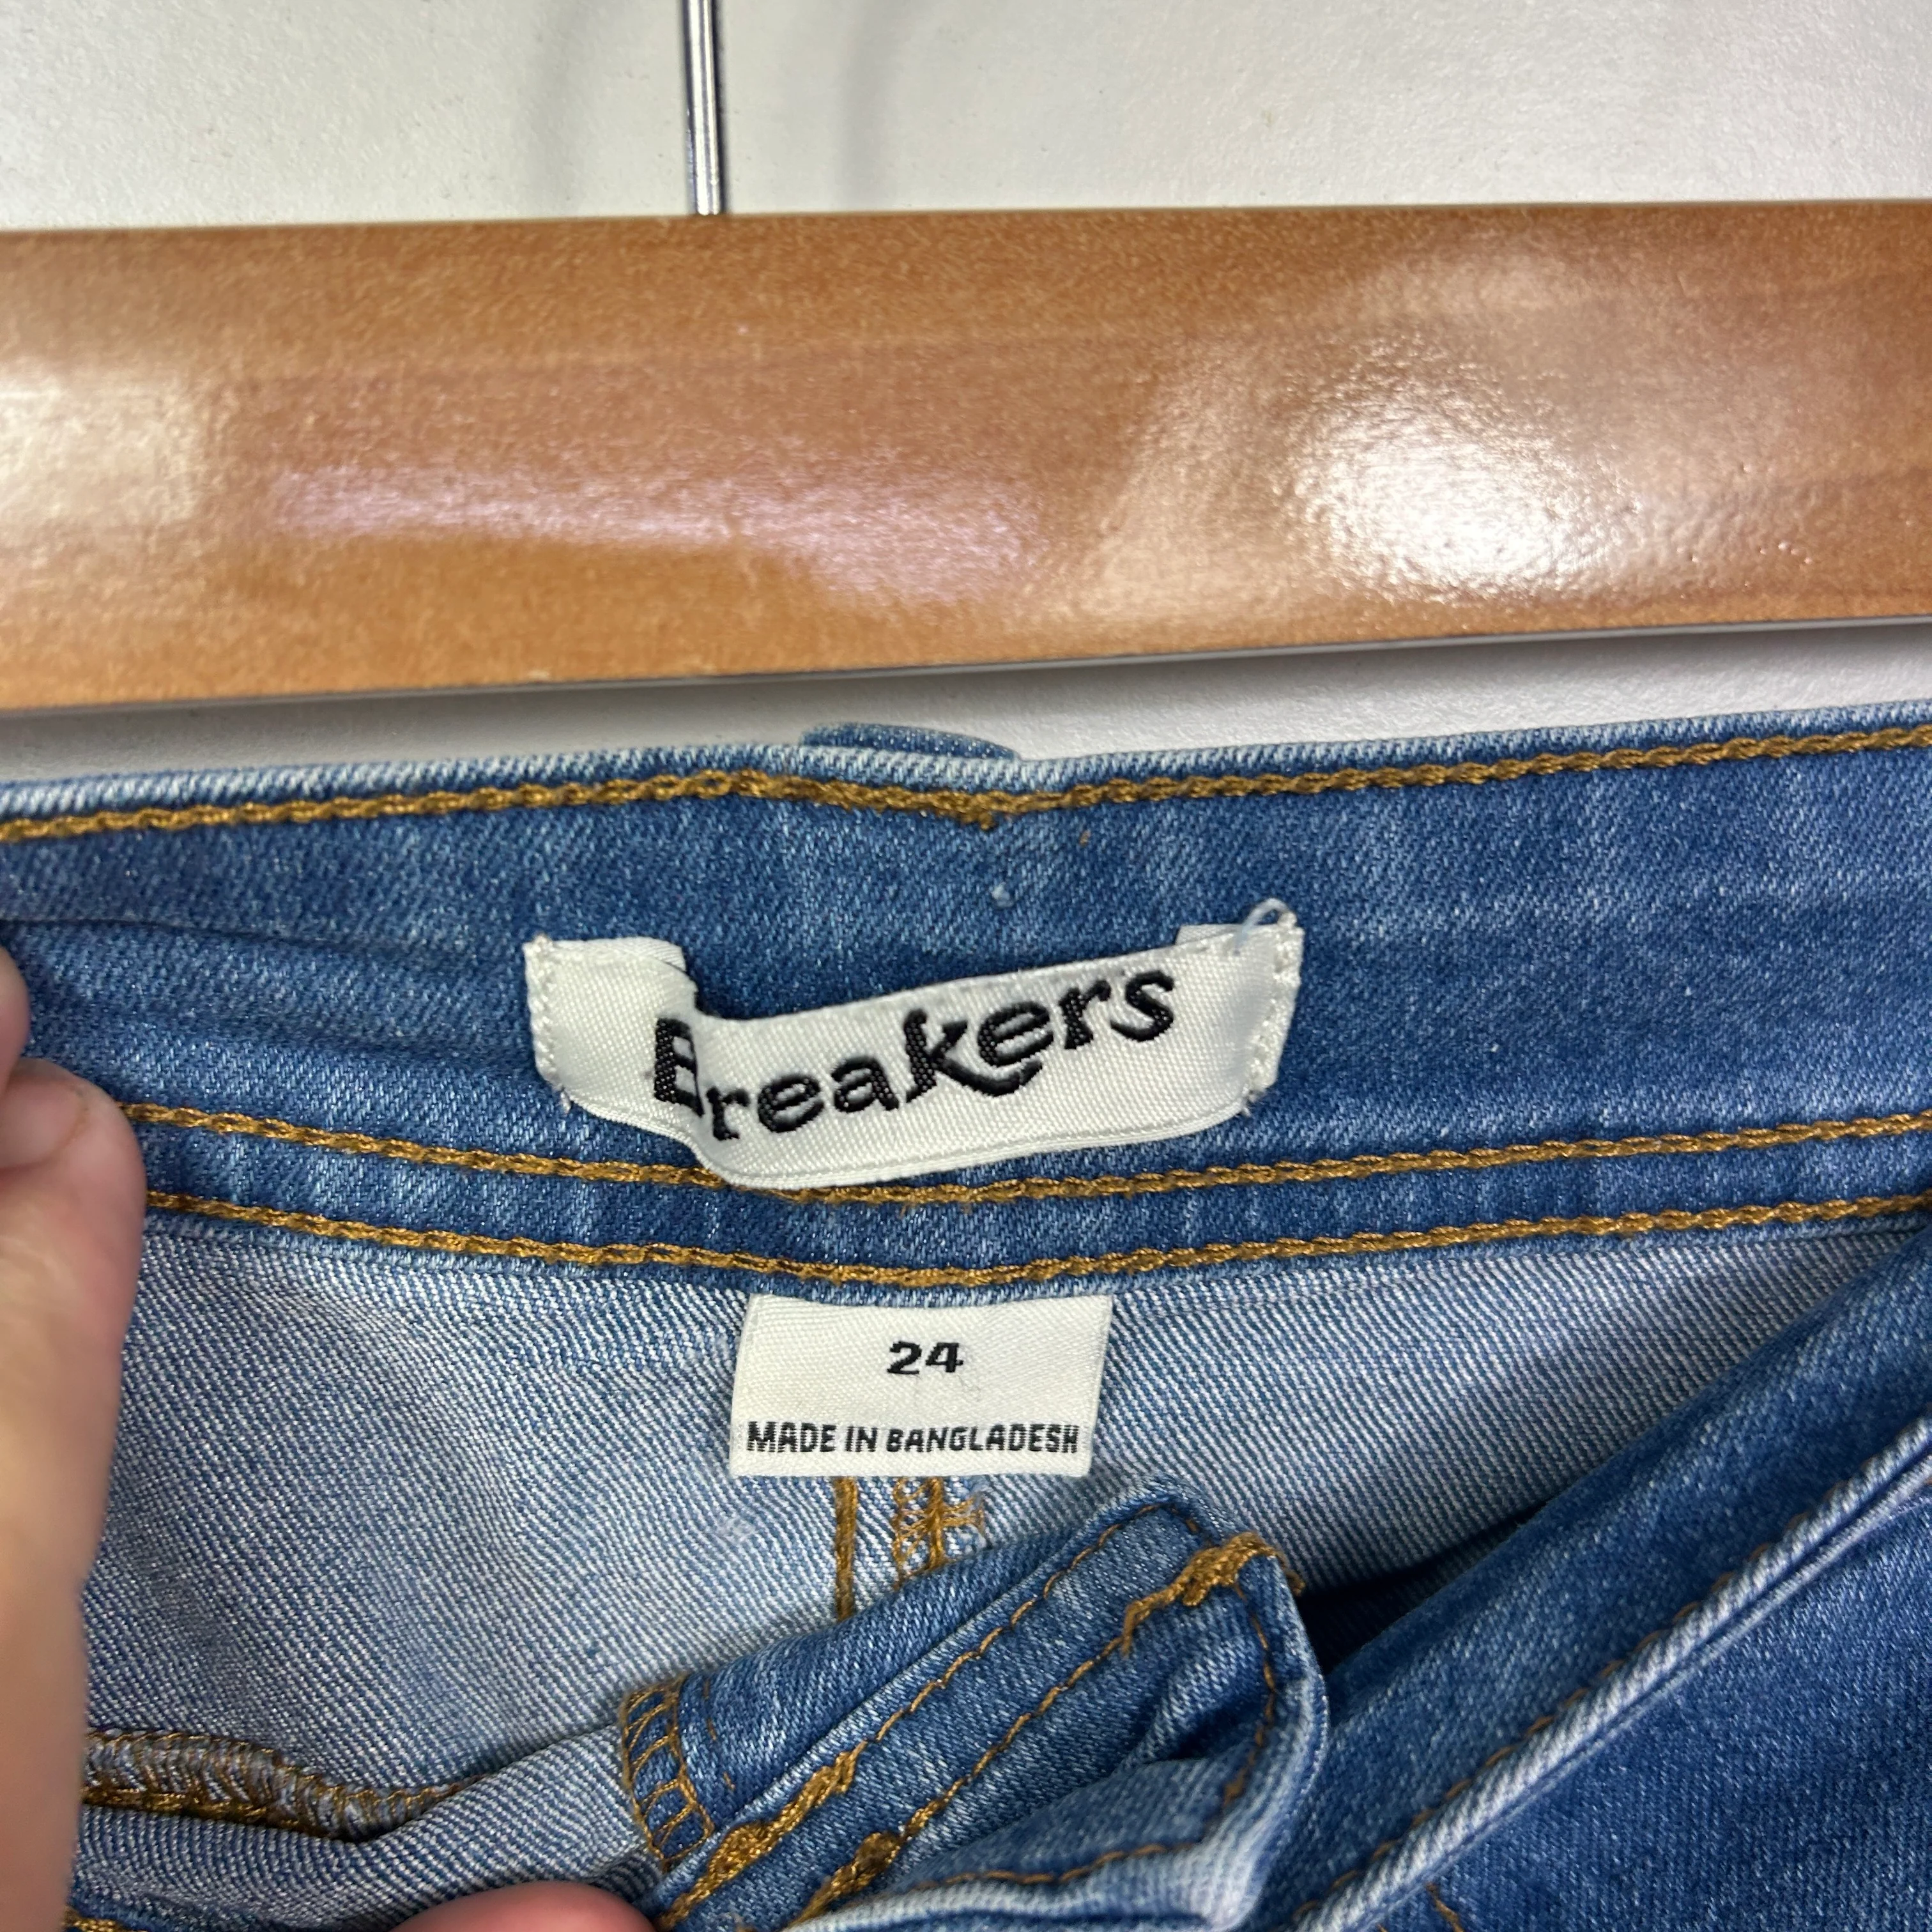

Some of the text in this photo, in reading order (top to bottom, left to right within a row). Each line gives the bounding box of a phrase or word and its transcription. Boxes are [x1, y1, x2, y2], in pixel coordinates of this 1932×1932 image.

[886, 1340, 964, 1375] 24
[746, 1421, 1079, 1453] MADE IN BANGLADESH
